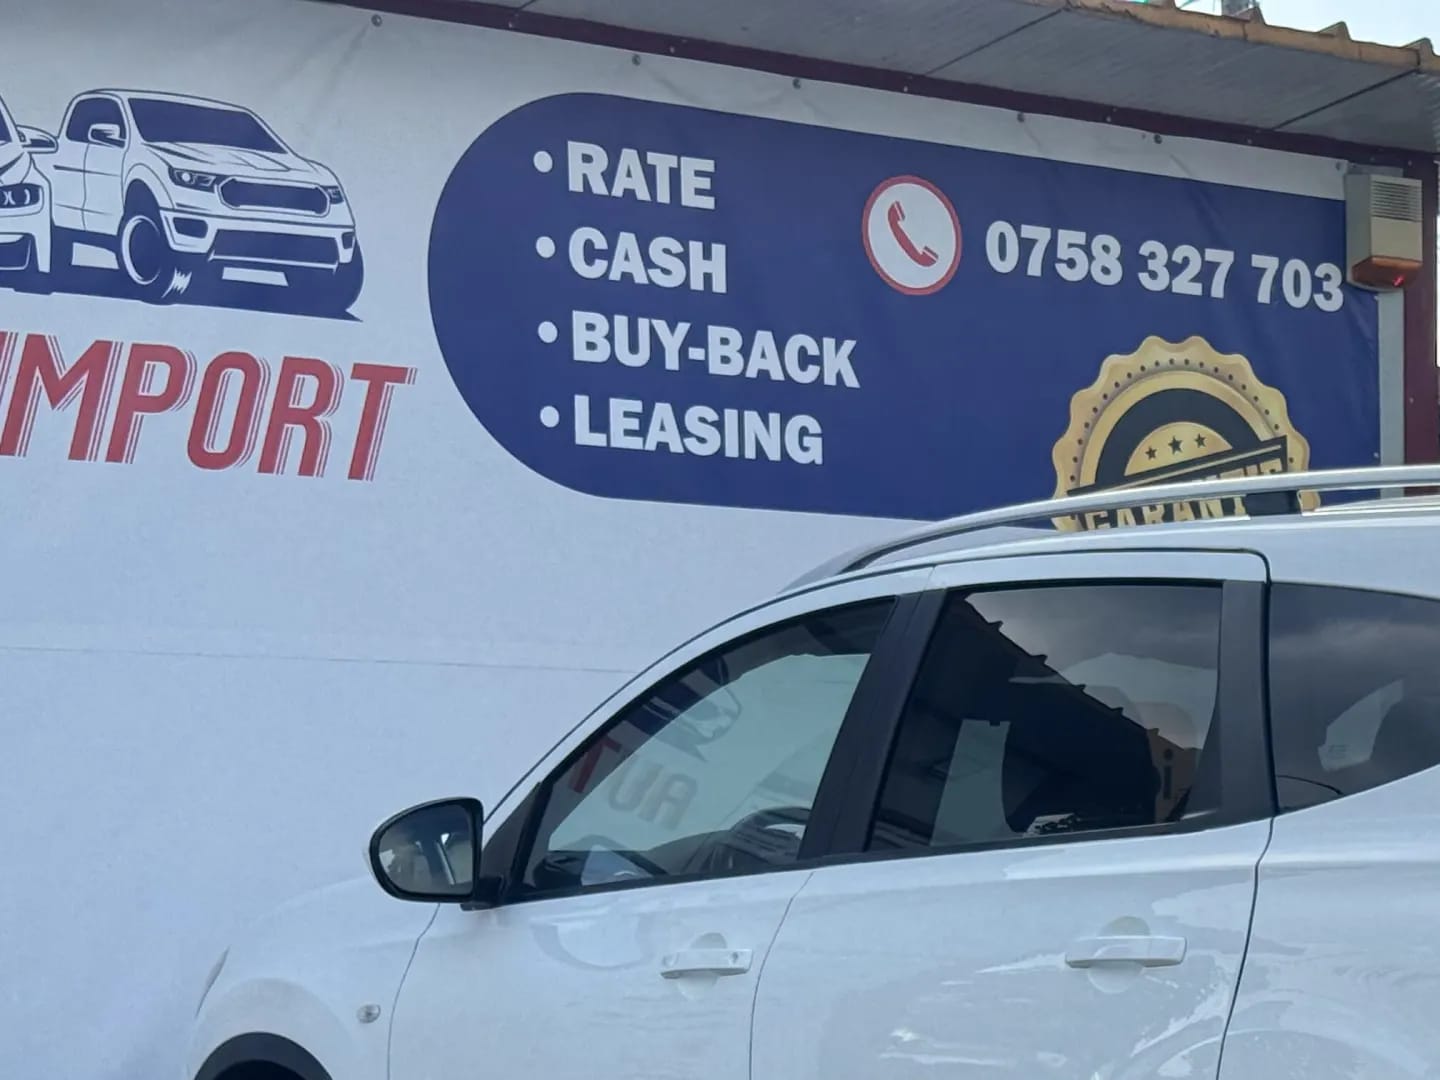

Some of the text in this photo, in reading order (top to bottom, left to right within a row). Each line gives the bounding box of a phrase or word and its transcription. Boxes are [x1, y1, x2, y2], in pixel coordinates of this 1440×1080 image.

[567, 140, 716, 210] RATE
[568, 226, 727, 293] CASH
[985, 220, 1344, 312] 0758 327 703
[572, 310, 860, 388] BUY-BACK
[574, 394, 824, 465] LEASING
